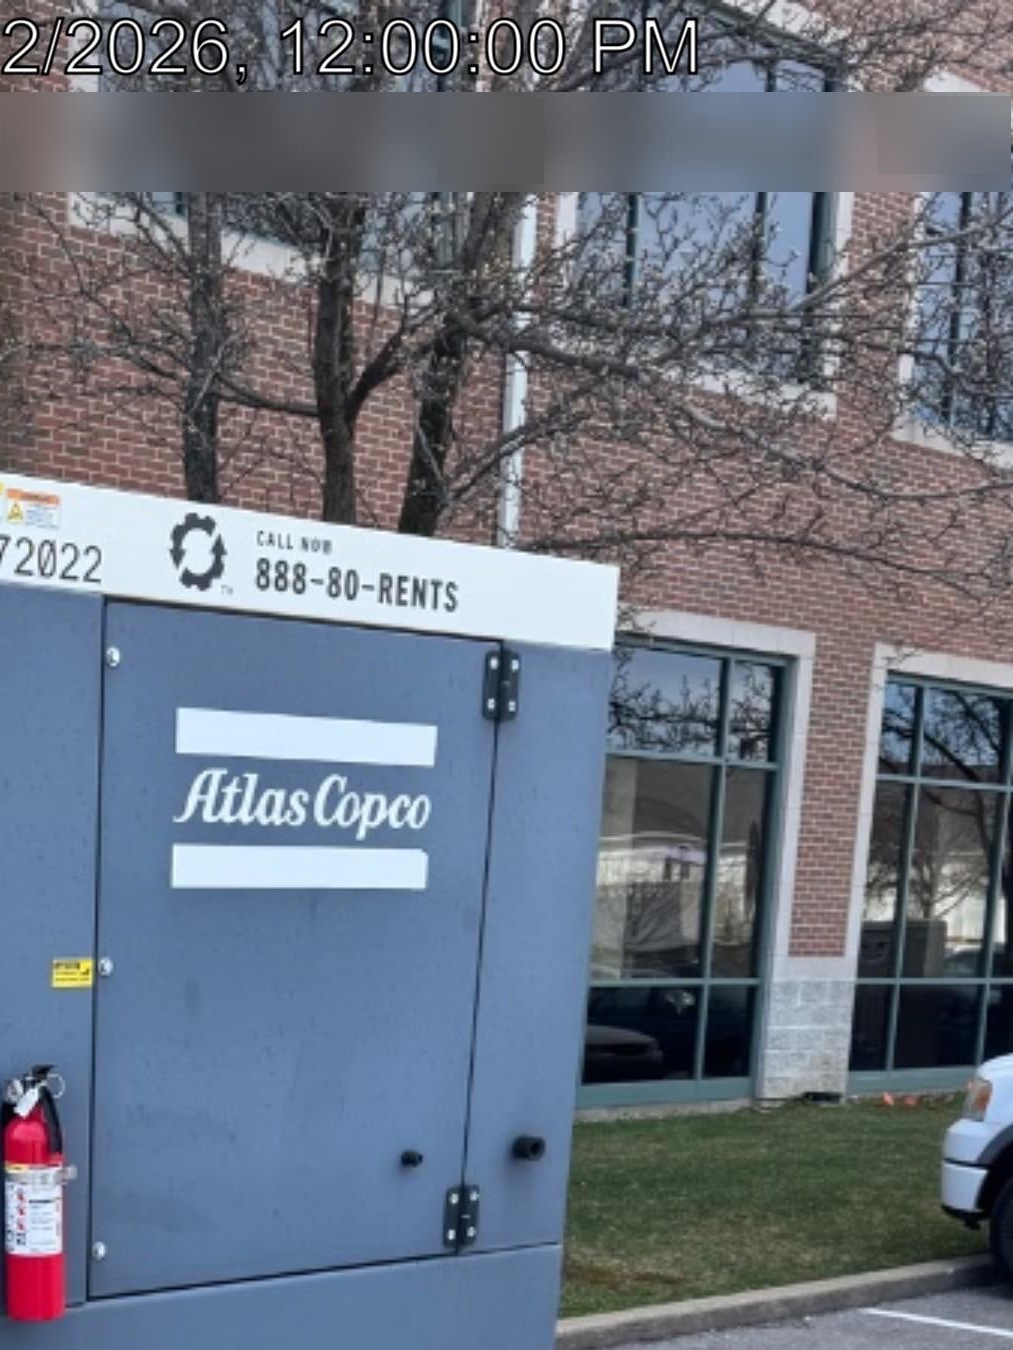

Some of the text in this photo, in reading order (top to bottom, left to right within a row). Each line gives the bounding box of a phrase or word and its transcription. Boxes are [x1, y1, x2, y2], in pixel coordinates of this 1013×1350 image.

[256, 530, 293, 551] CALL
[255, 557, 459, 613] 888-80-RENTS
[173, 768, 431, 840] Atlas Copco
